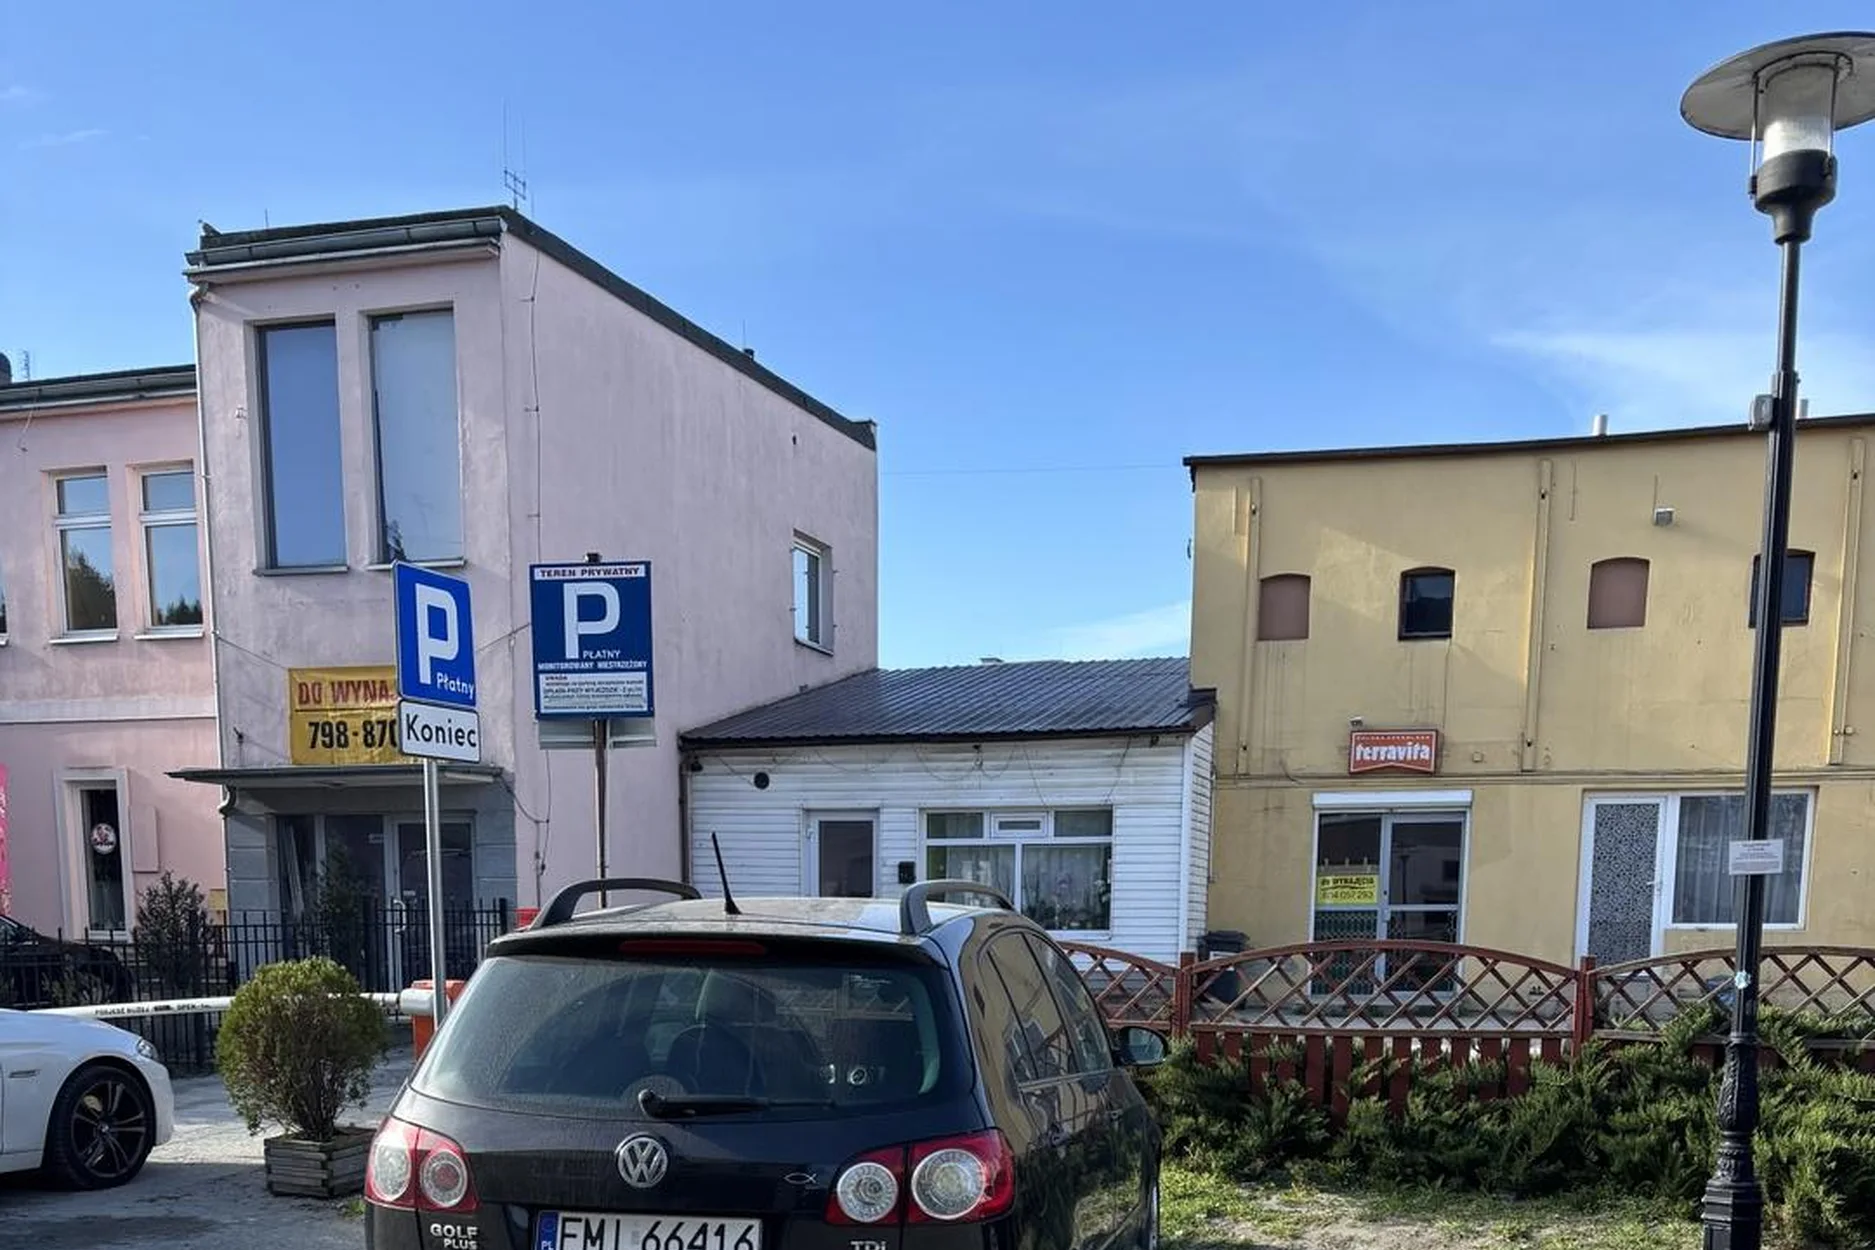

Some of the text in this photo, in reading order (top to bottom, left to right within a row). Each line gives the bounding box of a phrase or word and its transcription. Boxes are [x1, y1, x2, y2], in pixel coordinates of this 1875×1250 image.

[540, 566, 640, 577] TEREN PRYWATNY
[563, 582, 620, 660] P
[415, 583, 459, 685] P
[582, 649, 621, 660] PŁATNY
[298, 679, 397, 705] DO WYNA
[436, 672, 475, 700] Płatny
[406, 713, 477, 747] Koniec
[1355, 742, 1431, 761] terravita
[430, 1223, 478, 1239] GOLF
[444, 1238, 477, 1250] PLUS
[541, 1240, 554, 1250] PL
